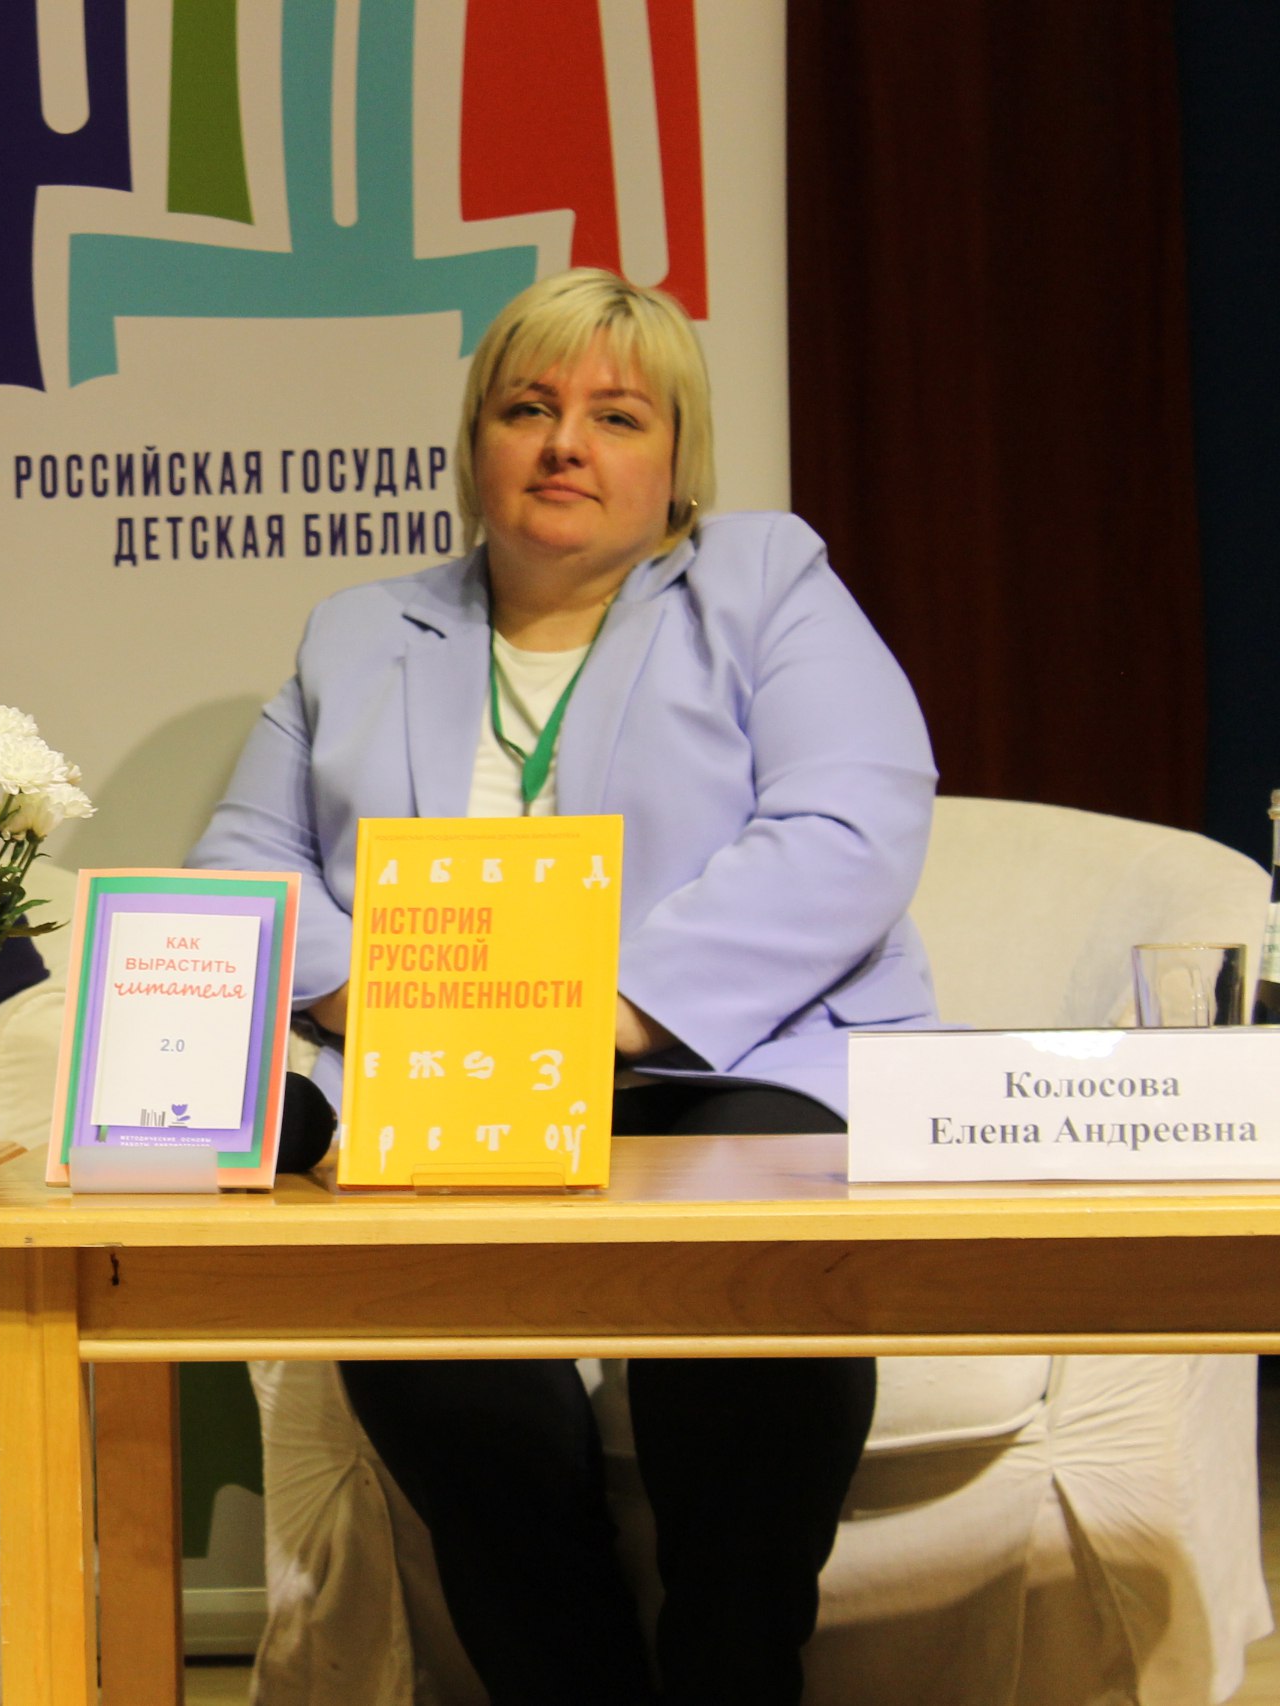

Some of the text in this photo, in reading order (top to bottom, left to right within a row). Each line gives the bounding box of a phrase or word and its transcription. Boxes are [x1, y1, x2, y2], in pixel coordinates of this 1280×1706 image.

[15, 446, 262, 499] РОССИЙСКАЯ
[114, 515, 285, 567] ДЕТСКАЯ
[370, 907, 493, 935] ИСТОРИЯ
[166, 936, 201, 950] КАК
[368, 938, 489, 972] РУССКОЙ
[125, 957, 237, 974] ВЫРАСТИТЬ
[113, 981, 247, 999] читателя
[366, 980, 583, 1010] ПИСЬМЕННОСТИ
[160, 1038, 186, 1053] 2.0
[1004, 1070, 1181, 1099] Колосова
[927, 1115, 1259, 1152] Елена Андреевна
